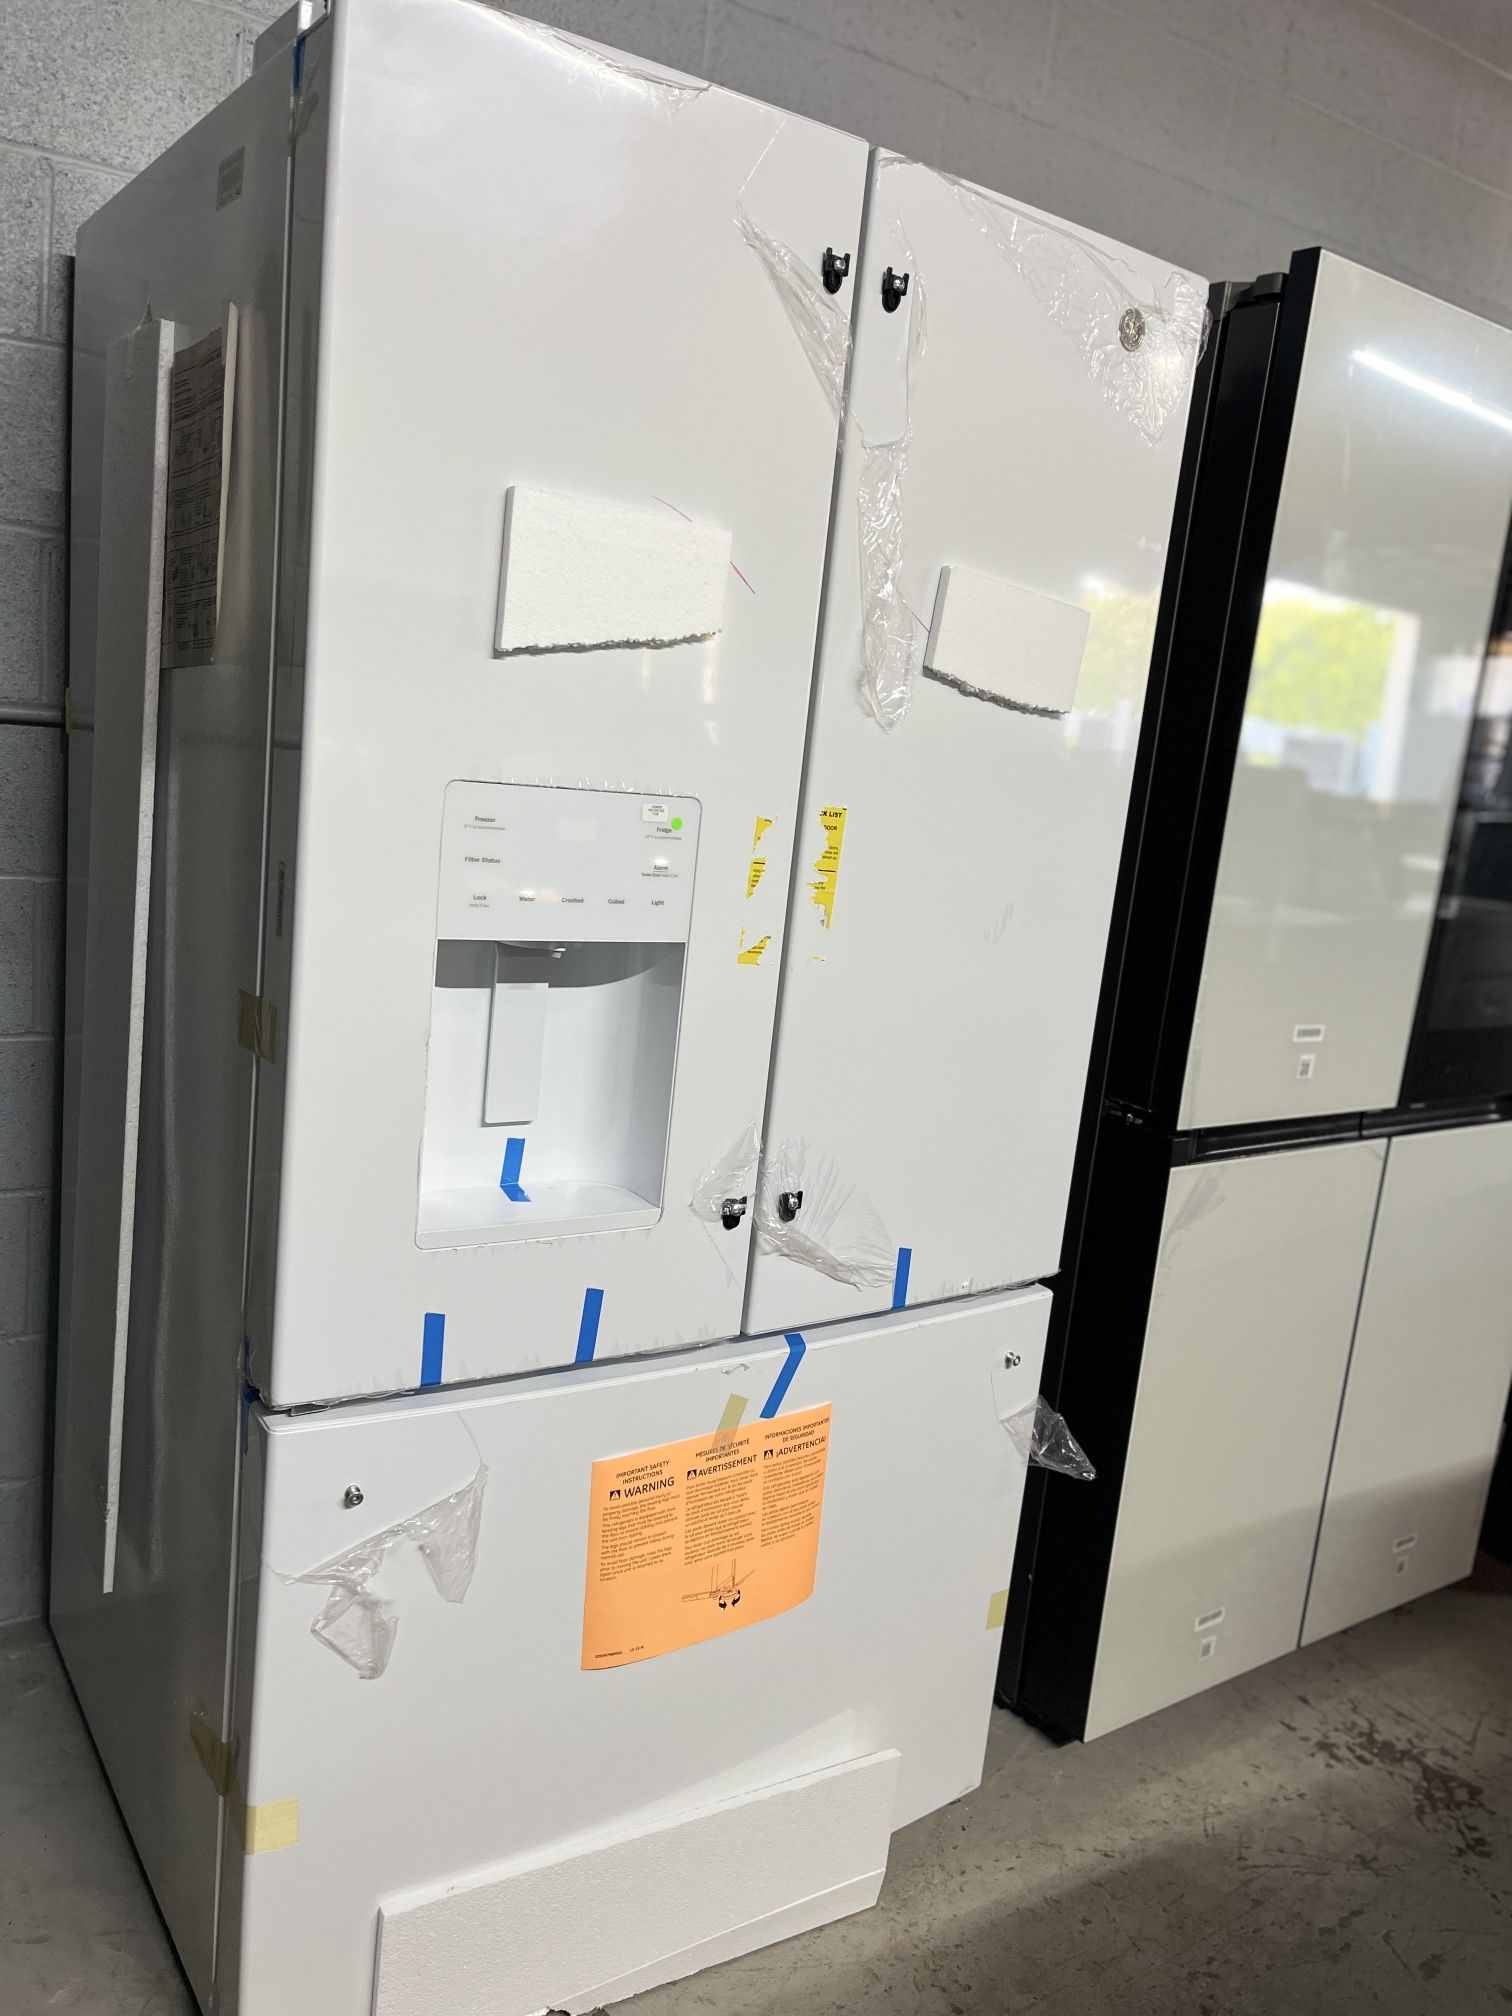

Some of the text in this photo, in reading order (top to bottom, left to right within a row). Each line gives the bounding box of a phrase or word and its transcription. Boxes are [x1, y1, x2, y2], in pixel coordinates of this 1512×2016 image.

[474, 815, 496, 823] Freezer
[651, 899, 665, 907] Light
[615, 1460, 670, 1479] IMPORTANT SAFETY
[698, 1454, 757, 1478] AVERTISSEMENT
[622, 1469, 663, 1485] INSTRUCTIONS
[624, 1476, 675, 1498] WARNING
